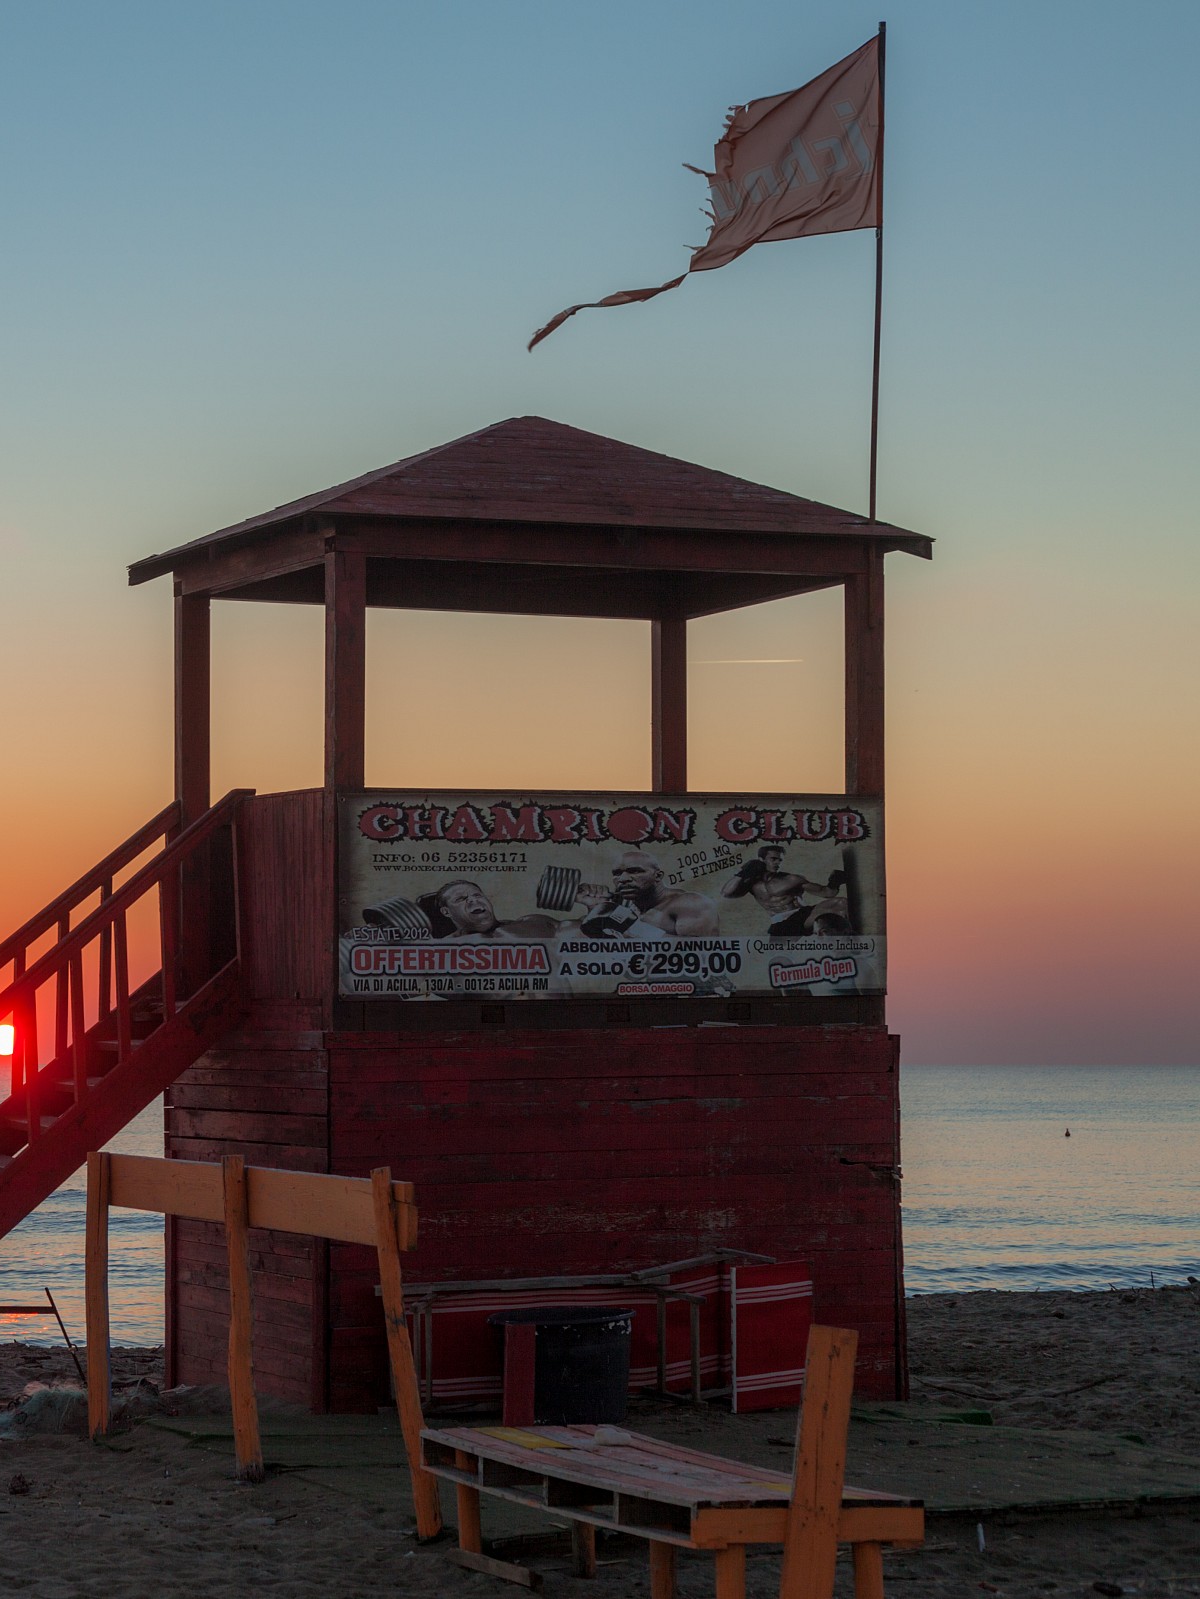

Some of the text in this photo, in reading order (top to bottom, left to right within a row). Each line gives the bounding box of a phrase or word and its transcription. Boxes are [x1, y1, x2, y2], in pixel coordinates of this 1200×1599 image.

[359, 803, 870, 843] CHAMPION CLUB
[372, 851, 527, 864] INFO: 06 52356171
[678, 844, 732, 869] 1000 MQ
[669, 853, 743, 885] DI FITNESS
[352, 926, 430, 941] ESTATE 2012
[559, 940, 740, 953] ABBONAMENTO ANNUALE
[787, 940, 833, 951] Iscrizione
[354, 948, 546, 971] OFFERTISSIMA
[559, 963, 573, 976] A
[577, 962, 624, 976] SOLO
[651, 952, 741, 978] 299,00
[773, 960, 852, 983] Formula Open
[353, 978, 370, 992] VIA
[373, 978, 383, 992] DI
[386, 978, 420, 993] ACILIA,
[425, 978, 454, 992] 130/A
[464, 978, 495, 991] 00125
[498, 978, 531, 991] ACILIA
[532, 978, 549, 991] RM
[620, 984, 693, 993] BORSA OMAGGIO
